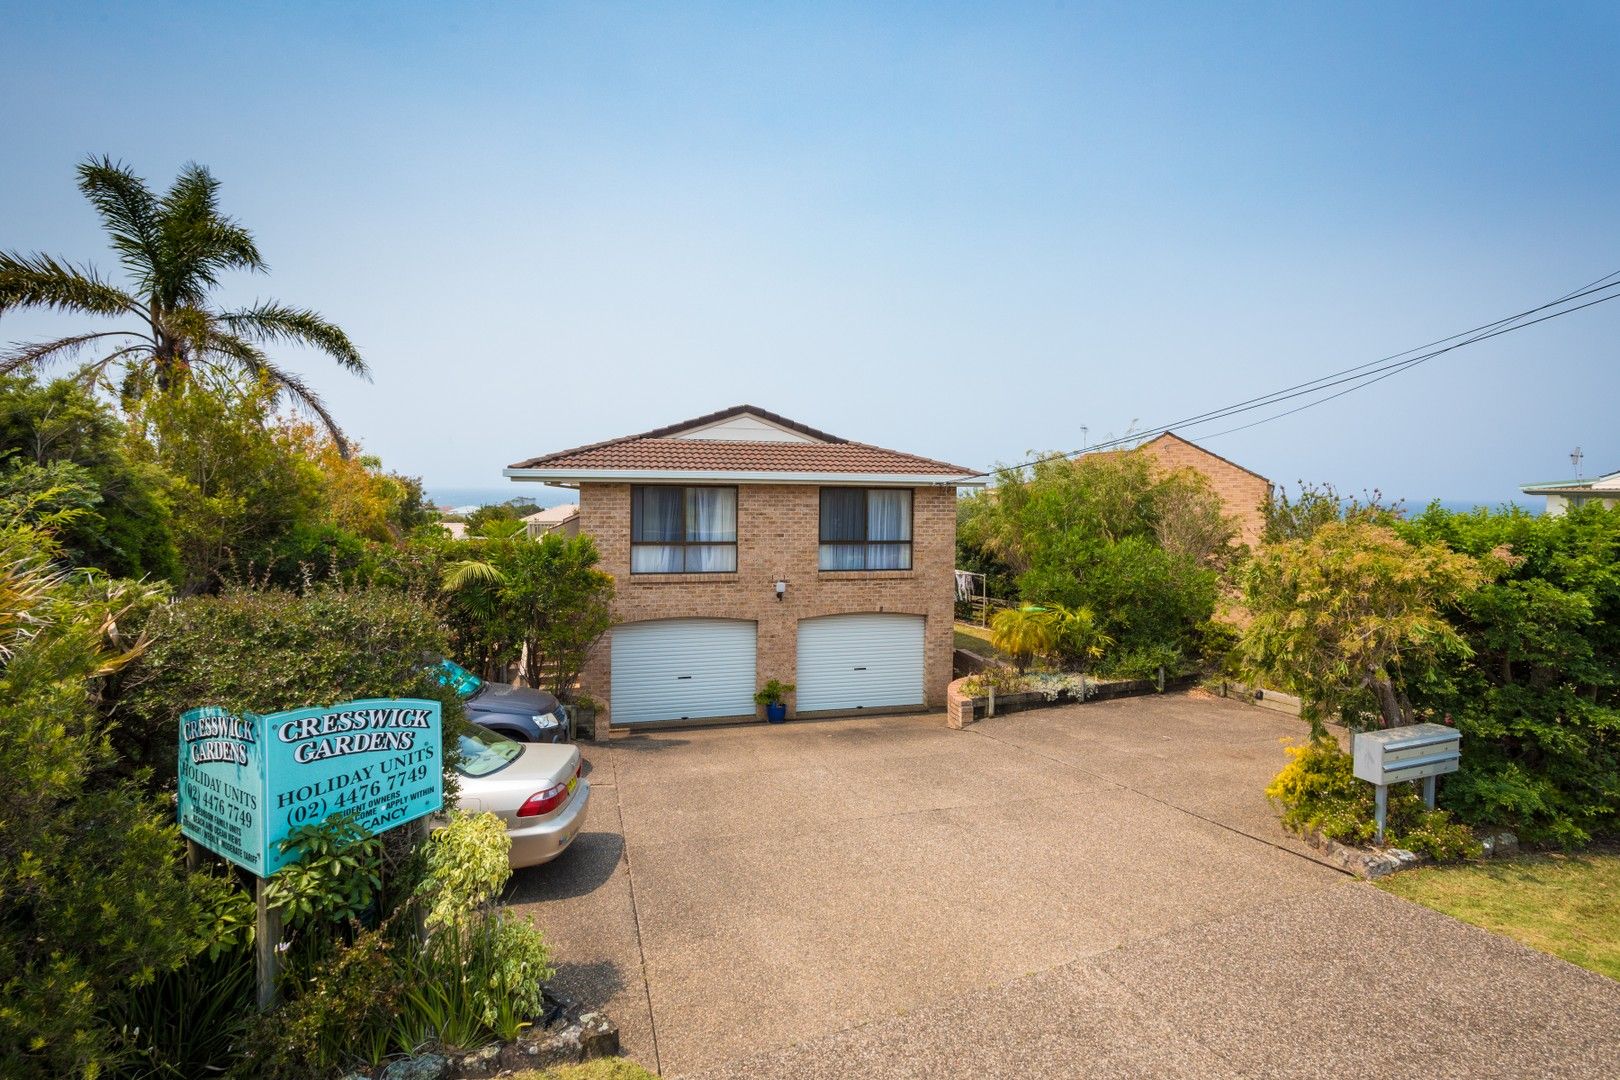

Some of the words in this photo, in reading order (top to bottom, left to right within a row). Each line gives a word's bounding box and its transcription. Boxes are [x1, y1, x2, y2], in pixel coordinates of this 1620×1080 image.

[183, 716, 256, 743] CRESSWICK
[278, 708, 433, 743] CRESSWICK
[191, 741, 248, 766] GARDENS
[294, 731, 416, 764] GARDENS
[182, 761, 222, 794] HOLIDAY
[224, 783, 257, 811] UNITS
[277, 765, 374, 809] HOLIDAY
[380, 745, 434, 774] UNITS
[184, 781, 201, 805] (02)
[203, 791, 225, 815] 4476
[228, 803, 252, 828] 7749
[287, 798, 327, 827] (02)
[334, 780, 381, 809] 4476
[387, 765, 427, 791] 7749
[368, 790, 401, 807] OWNERS
[385, 796, 409, 811] APPLY
[410, 786, 435, 802] WITHIN
[361, 805, 409, 831] CANCY
